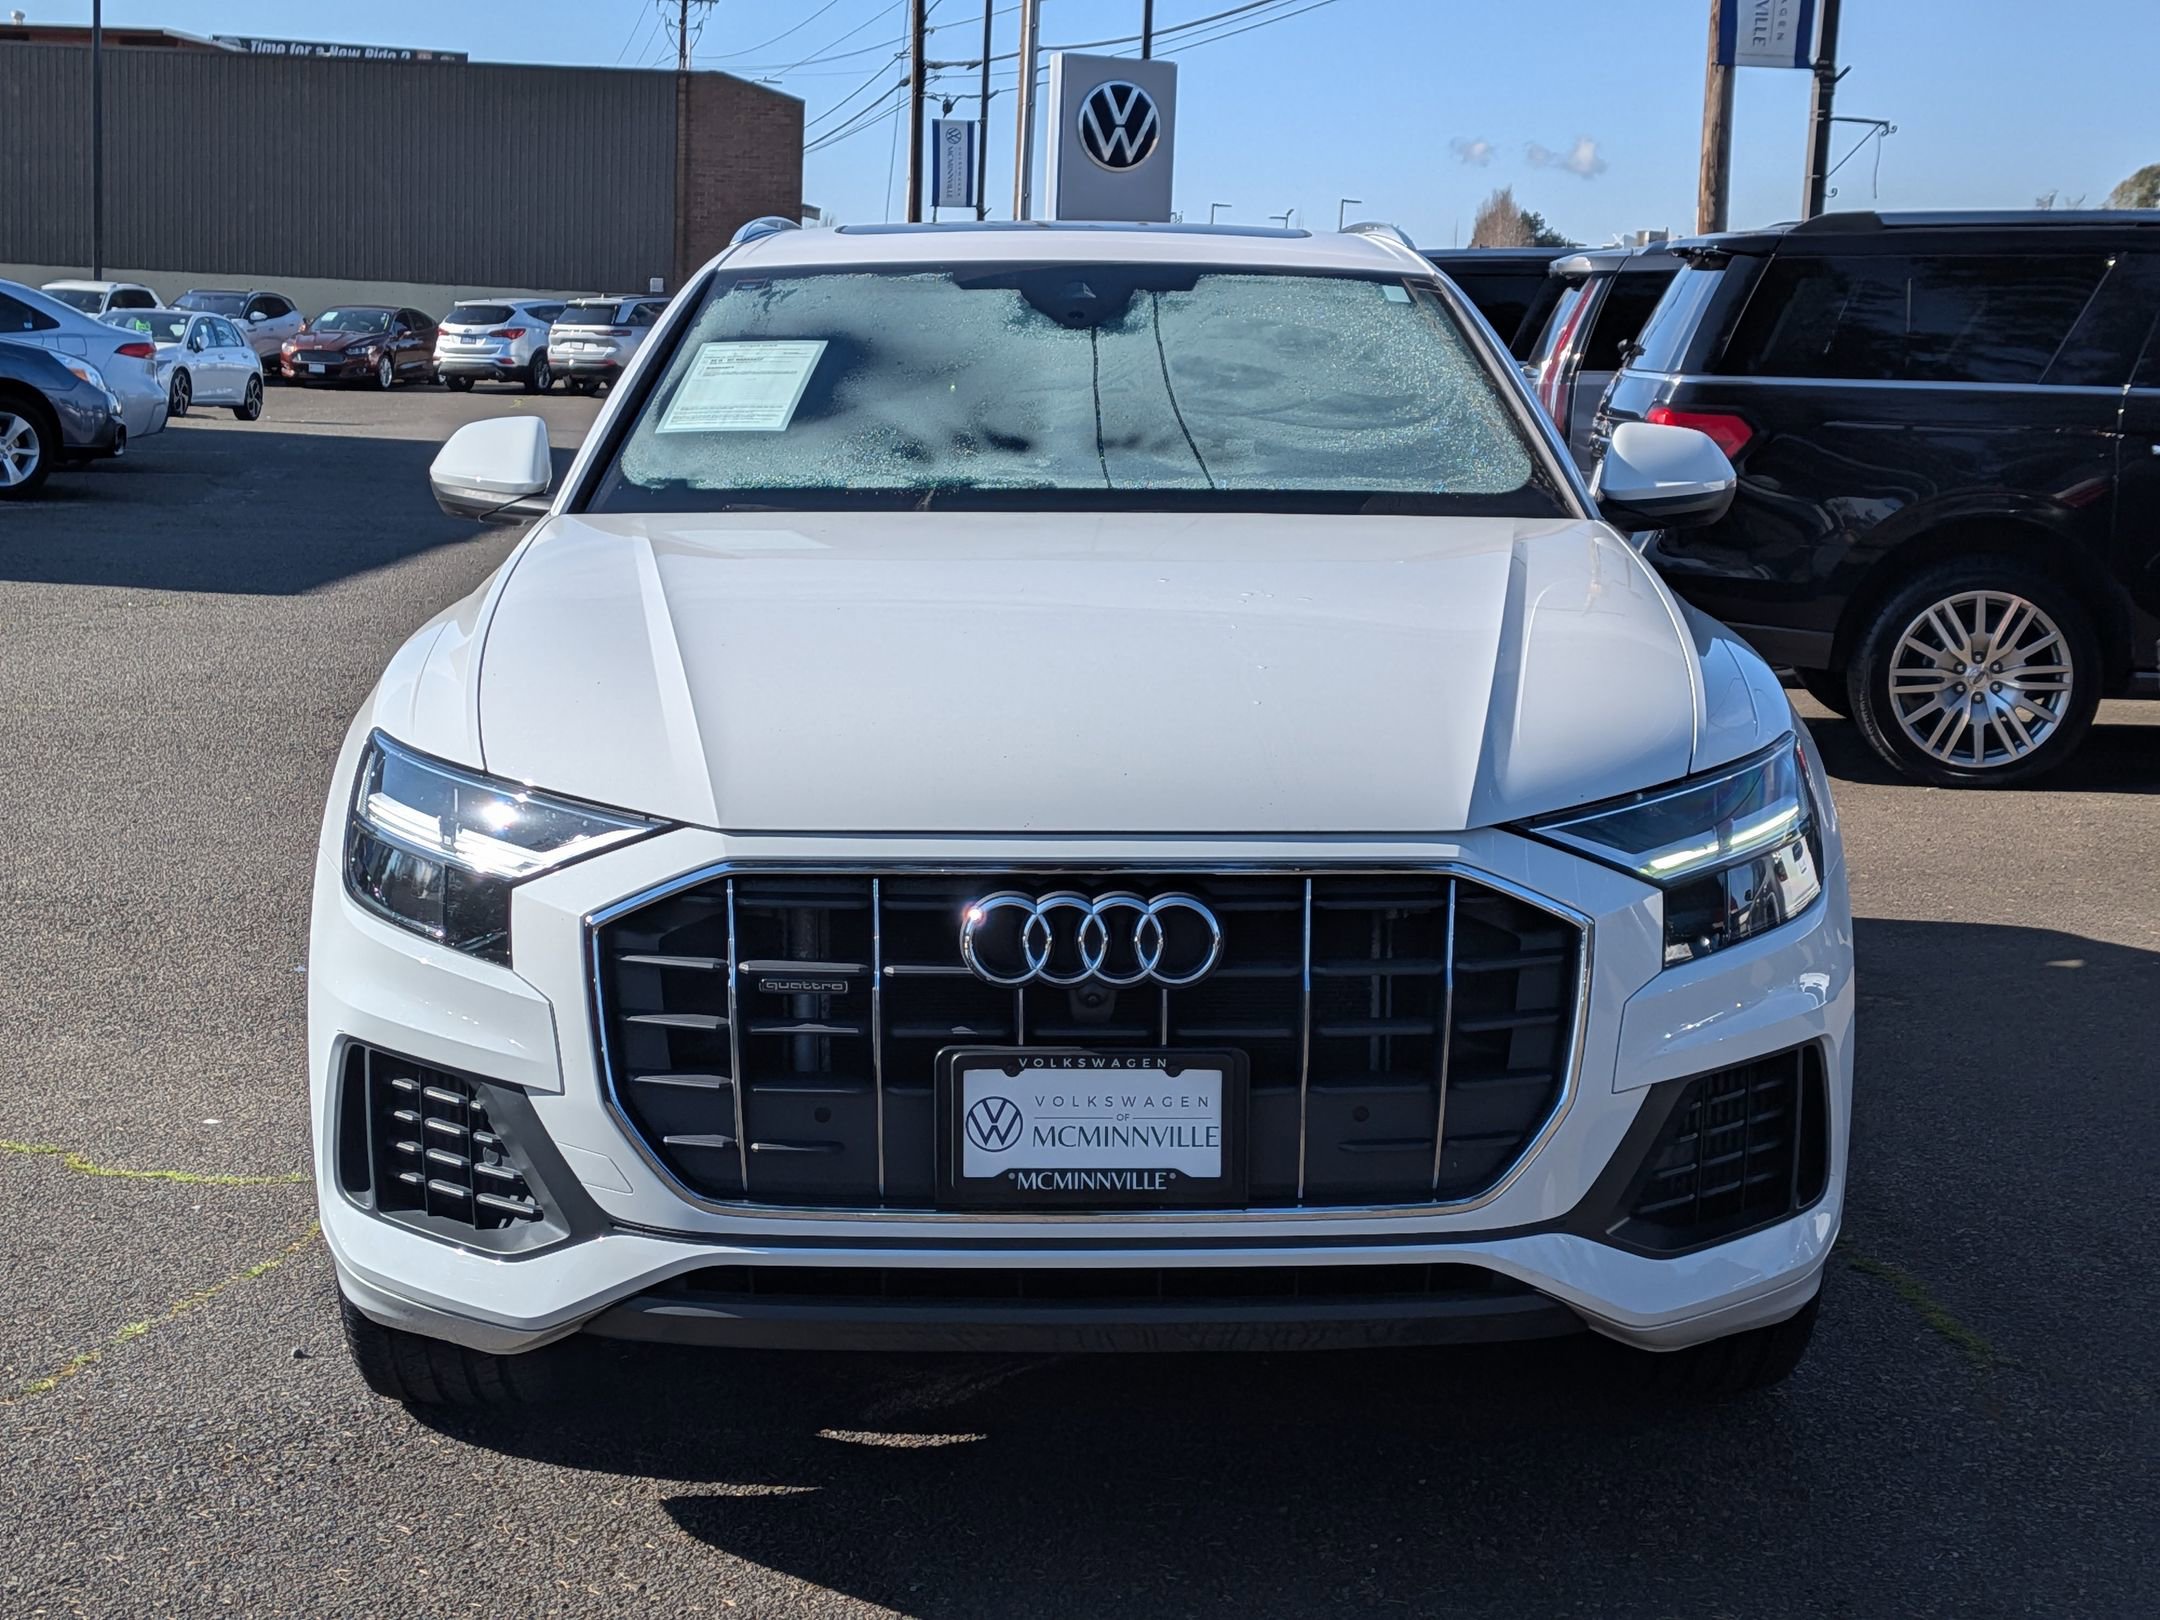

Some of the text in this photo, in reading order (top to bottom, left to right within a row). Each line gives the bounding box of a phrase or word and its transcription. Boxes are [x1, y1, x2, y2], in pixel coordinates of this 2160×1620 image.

[250, 39, 286, 55] Time
[289, 43, 312, 56] for
[1080, 82, 1159, 168] VW
[766, 981, 843, 990] quattro
[1018, 1057, 1168, 1068] VOLKSWAGEN
[1034, 1095, 1209, 1108] VOLKSWAGEN
[1116, 1113, 1131, 1122] OF
[1032, 1125, 1220, 1148] MCMINNVILLE
[1017, 1171, 1168, 1190] MCMINNVILLE
